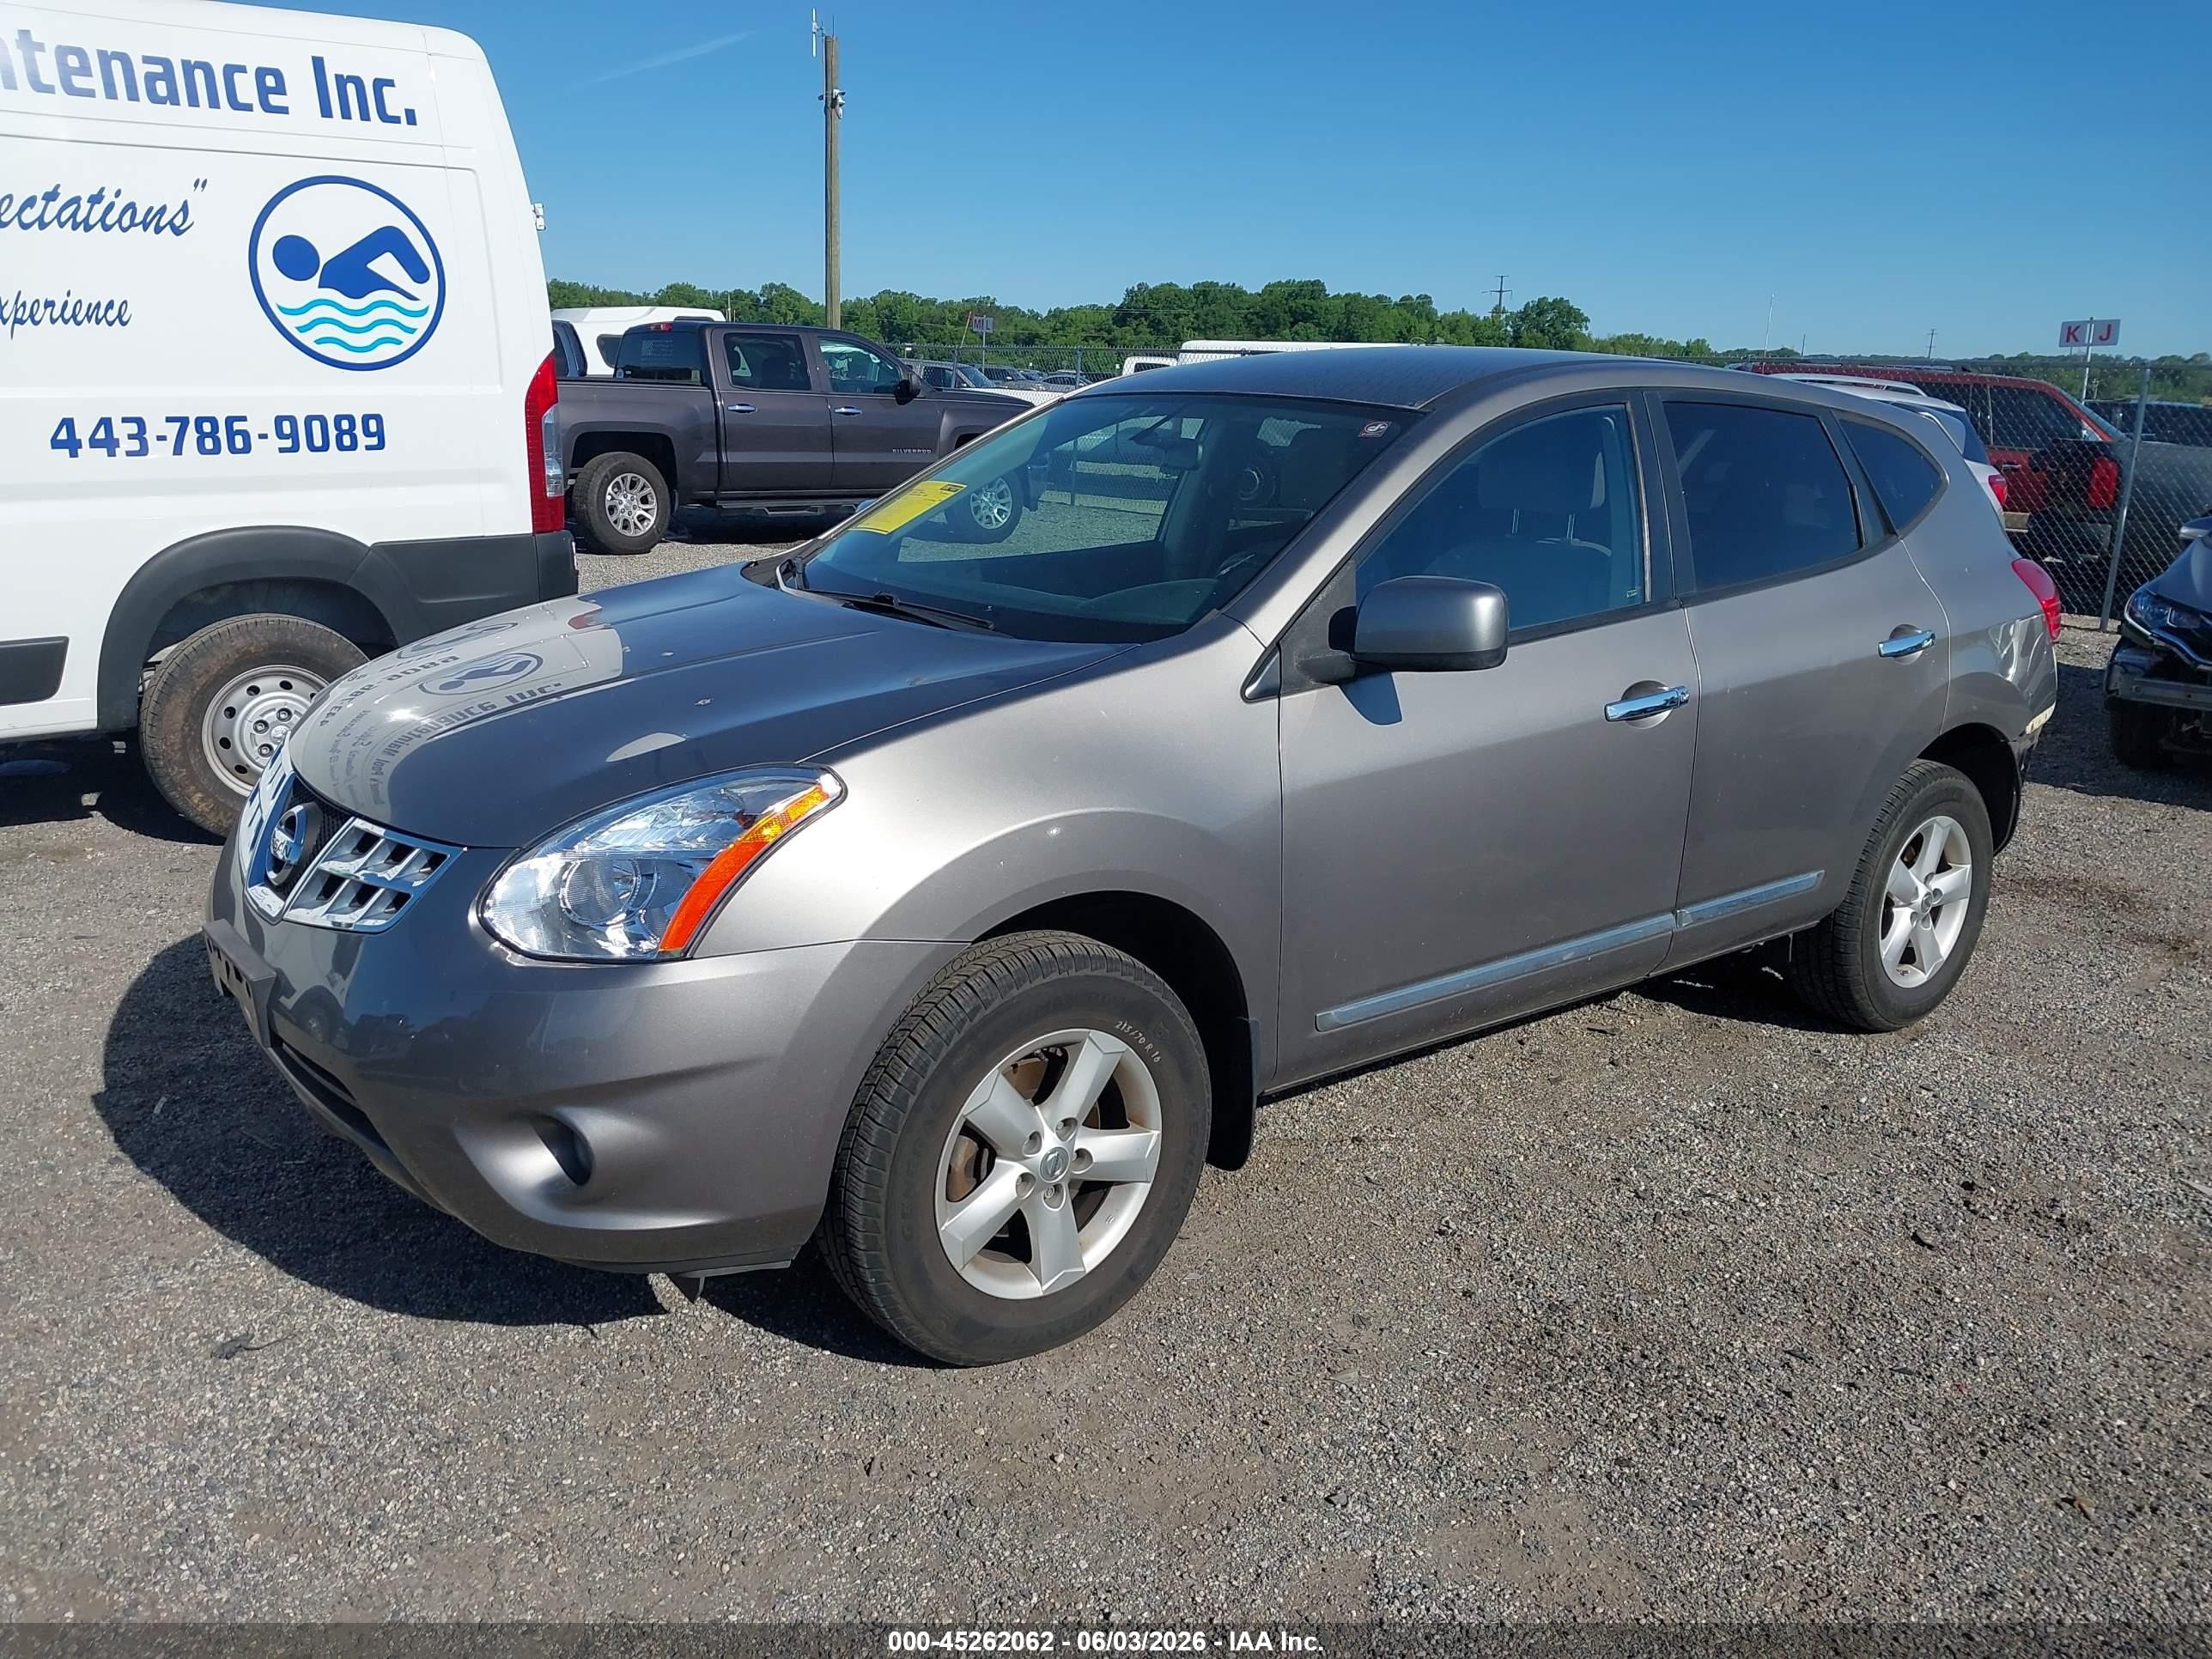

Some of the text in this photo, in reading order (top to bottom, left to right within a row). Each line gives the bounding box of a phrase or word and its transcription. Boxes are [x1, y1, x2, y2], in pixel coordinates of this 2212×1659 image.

[311, 56, 417, 125] Inc.
[2066, 324, 2112, 343] K J
[50, 413, 386, 458] 443-786-9089
